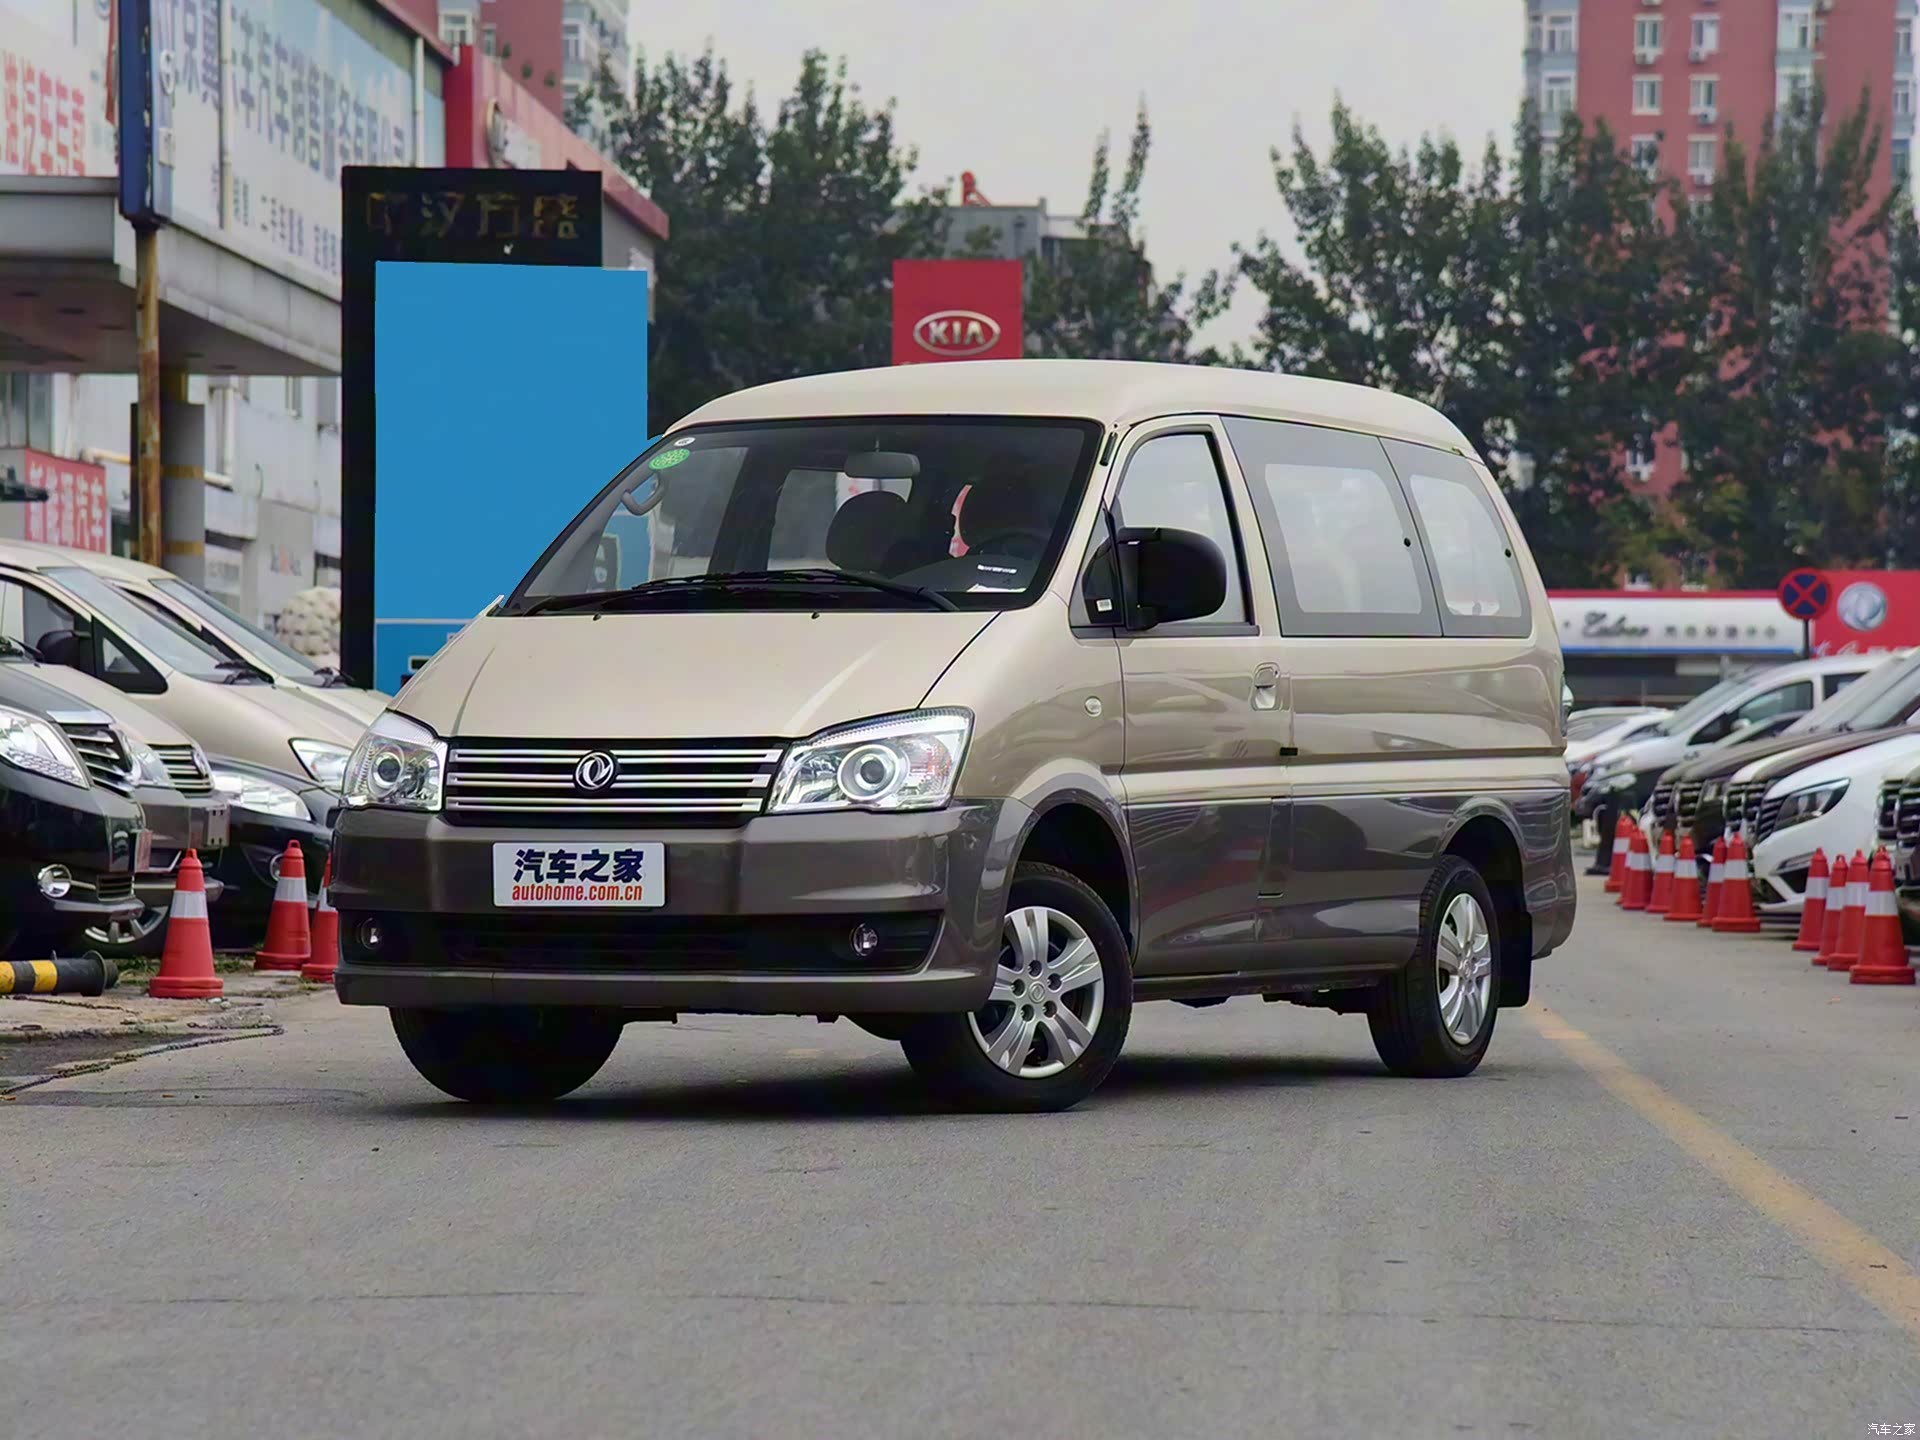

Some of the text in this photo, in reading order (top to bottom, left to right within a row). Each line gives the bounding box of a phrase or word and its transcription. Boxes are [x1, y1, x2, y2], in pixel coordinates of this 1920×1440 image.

[928, 320, 985, 345] KIA
[513, 848, 644, 883] 汽车之家
[512, 884, 643, 901] autohome.com.cn
